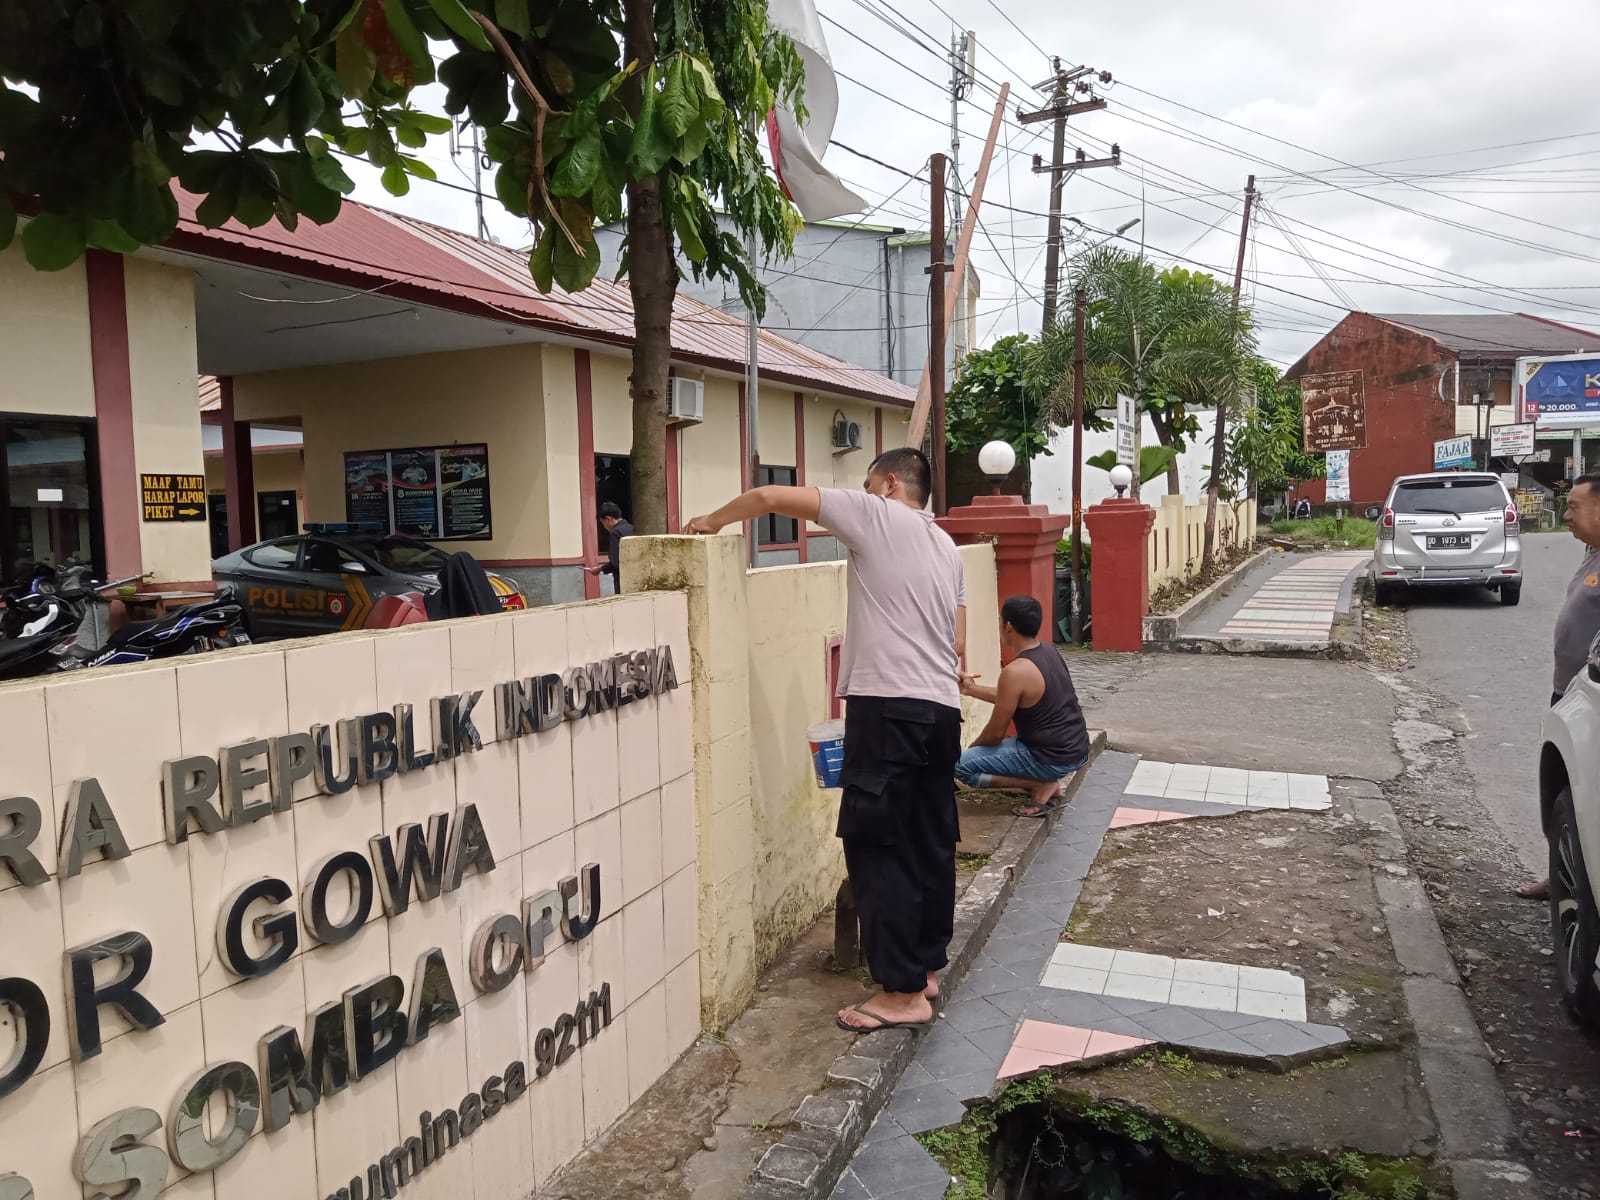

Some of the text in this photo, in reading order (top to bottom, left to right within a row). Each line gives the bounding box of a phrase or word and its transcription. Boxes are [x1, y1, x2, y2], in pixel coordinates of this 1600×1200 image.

[1546, 403, 1577, 411] 20.000
[1436, 440, 1470, 459] FAJAR
[143, 476, 203, 489] MAAF TAMU
[144, 490, 205, 504] HARAP LAPOR
[145, 505, 175, 519] PIKET
[248, 586, 326, 609] POLISI
[161, 688, 484, 846] REPUBLIK
[493, 644, 679, 742] INDONESIA
[214, 801, 497, 979] GOWA
[72, 862, 602, 1200] SOMBA OPU
[325, 981, 613, 1200] uminasa 92111
